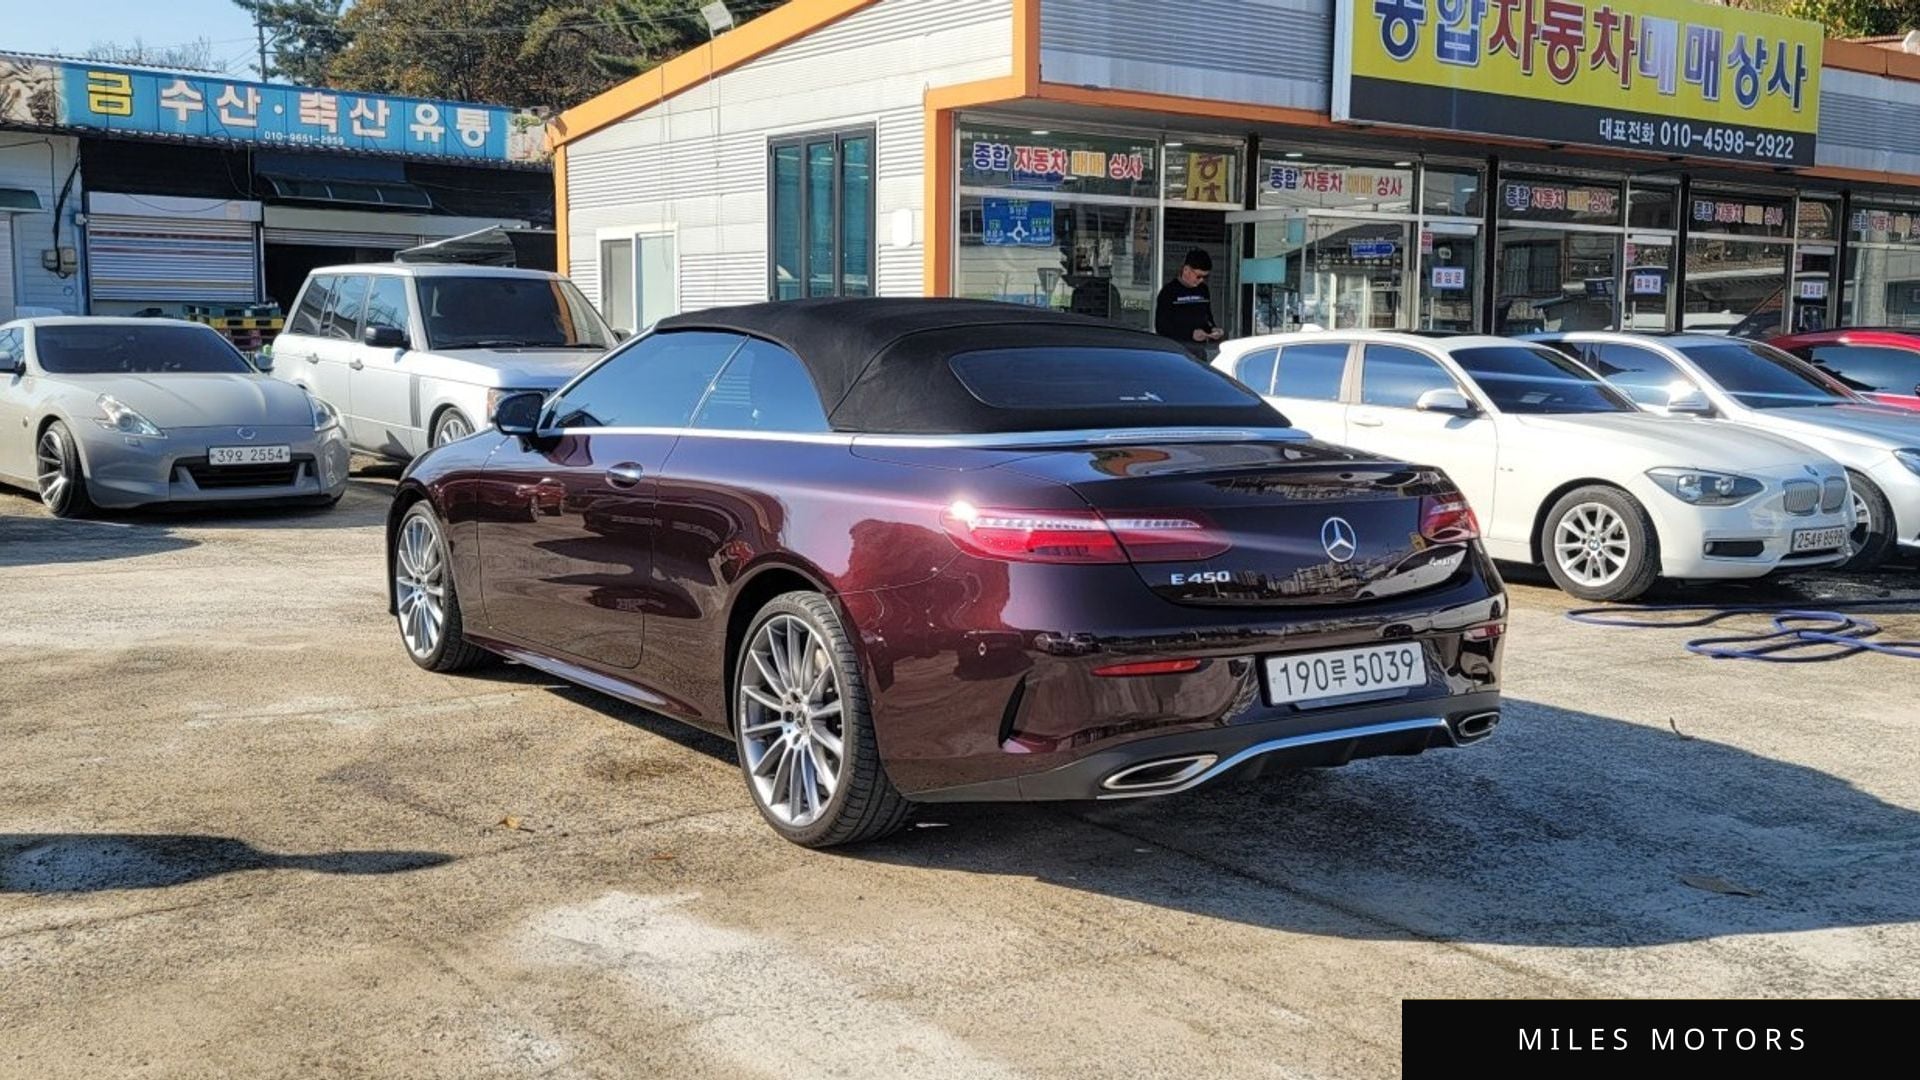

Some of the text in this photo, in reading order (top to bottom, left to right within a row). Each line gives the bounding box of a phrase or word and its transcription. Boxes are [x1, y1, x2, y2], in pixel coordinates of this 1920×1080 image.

[1600, 118, 1794, 159] 대표전화 010-4598-2922
[973, 142, 1010, 171] 종합
[1014, 145, 1067, 175] 자동차
[1109, 153, 1144, 180] 상사
[1270, 166, 1298, 190] 종합
[1303, 170, 1343, 193] 자동차
[1377, 176, 1403, 197] 상사
[250, 448, 283, 462] 2554
[1171, 570, 1230, 585] E 450
[1280, 649, 1414, 696] 190루 5039
